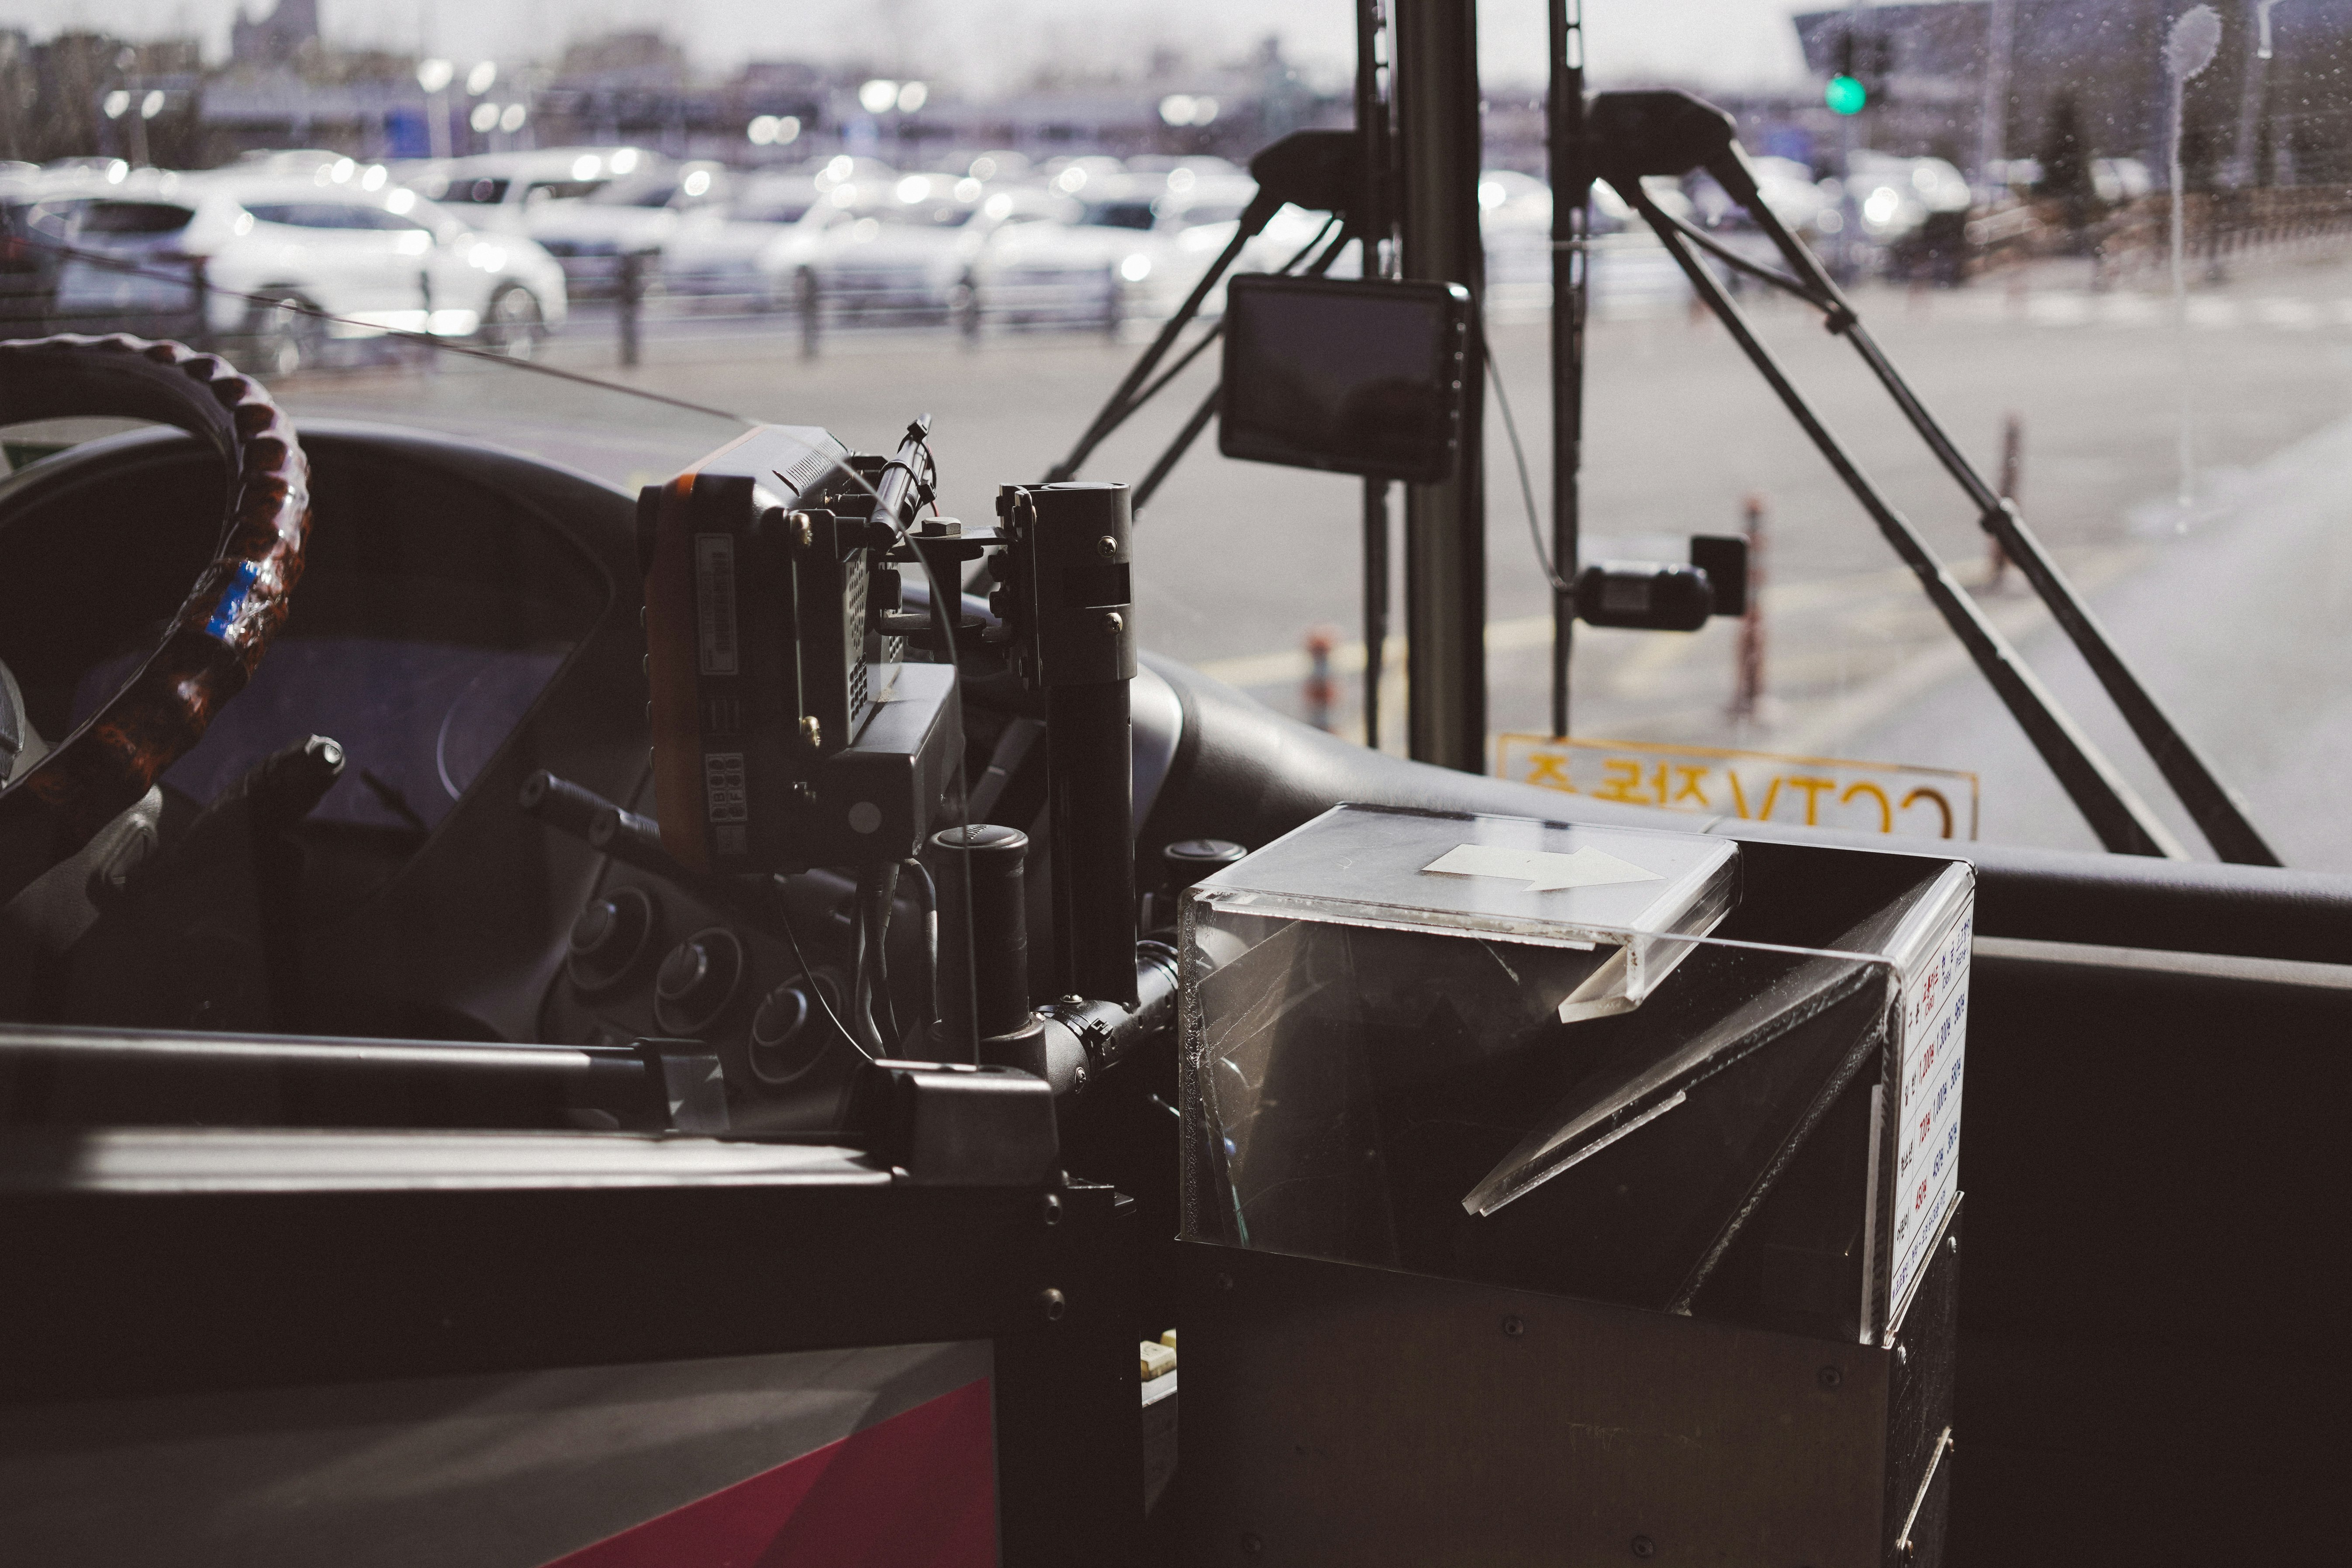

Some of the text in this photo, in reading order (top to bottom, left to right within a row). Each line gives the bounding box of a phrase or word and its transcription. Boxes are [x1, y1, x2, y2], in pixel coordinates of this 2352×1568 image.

[1923, 964, 1938, 1004] 교통카드
[1925, 992, 1934, 1020] (CARD)
[1942, 967, 1951, 993] (CASH)
[1920, 1040, 1934, 1085] 1,200원
[1937, 1013, 1951, 1057] 1,300원
[1955, 991, 1965, 1025] 960원
[1901, 1138, 1913, 1178] 청소년
[1919, 1109, 1931, 1148] 720원
[1933, 1079, 1948, 1122] 1,000원
[1897, 1206, 1909, 1244] 어린이
[1915, 1175, 1927, 1213] 450원
[1933, 1144, 1944, 1180] 450원
